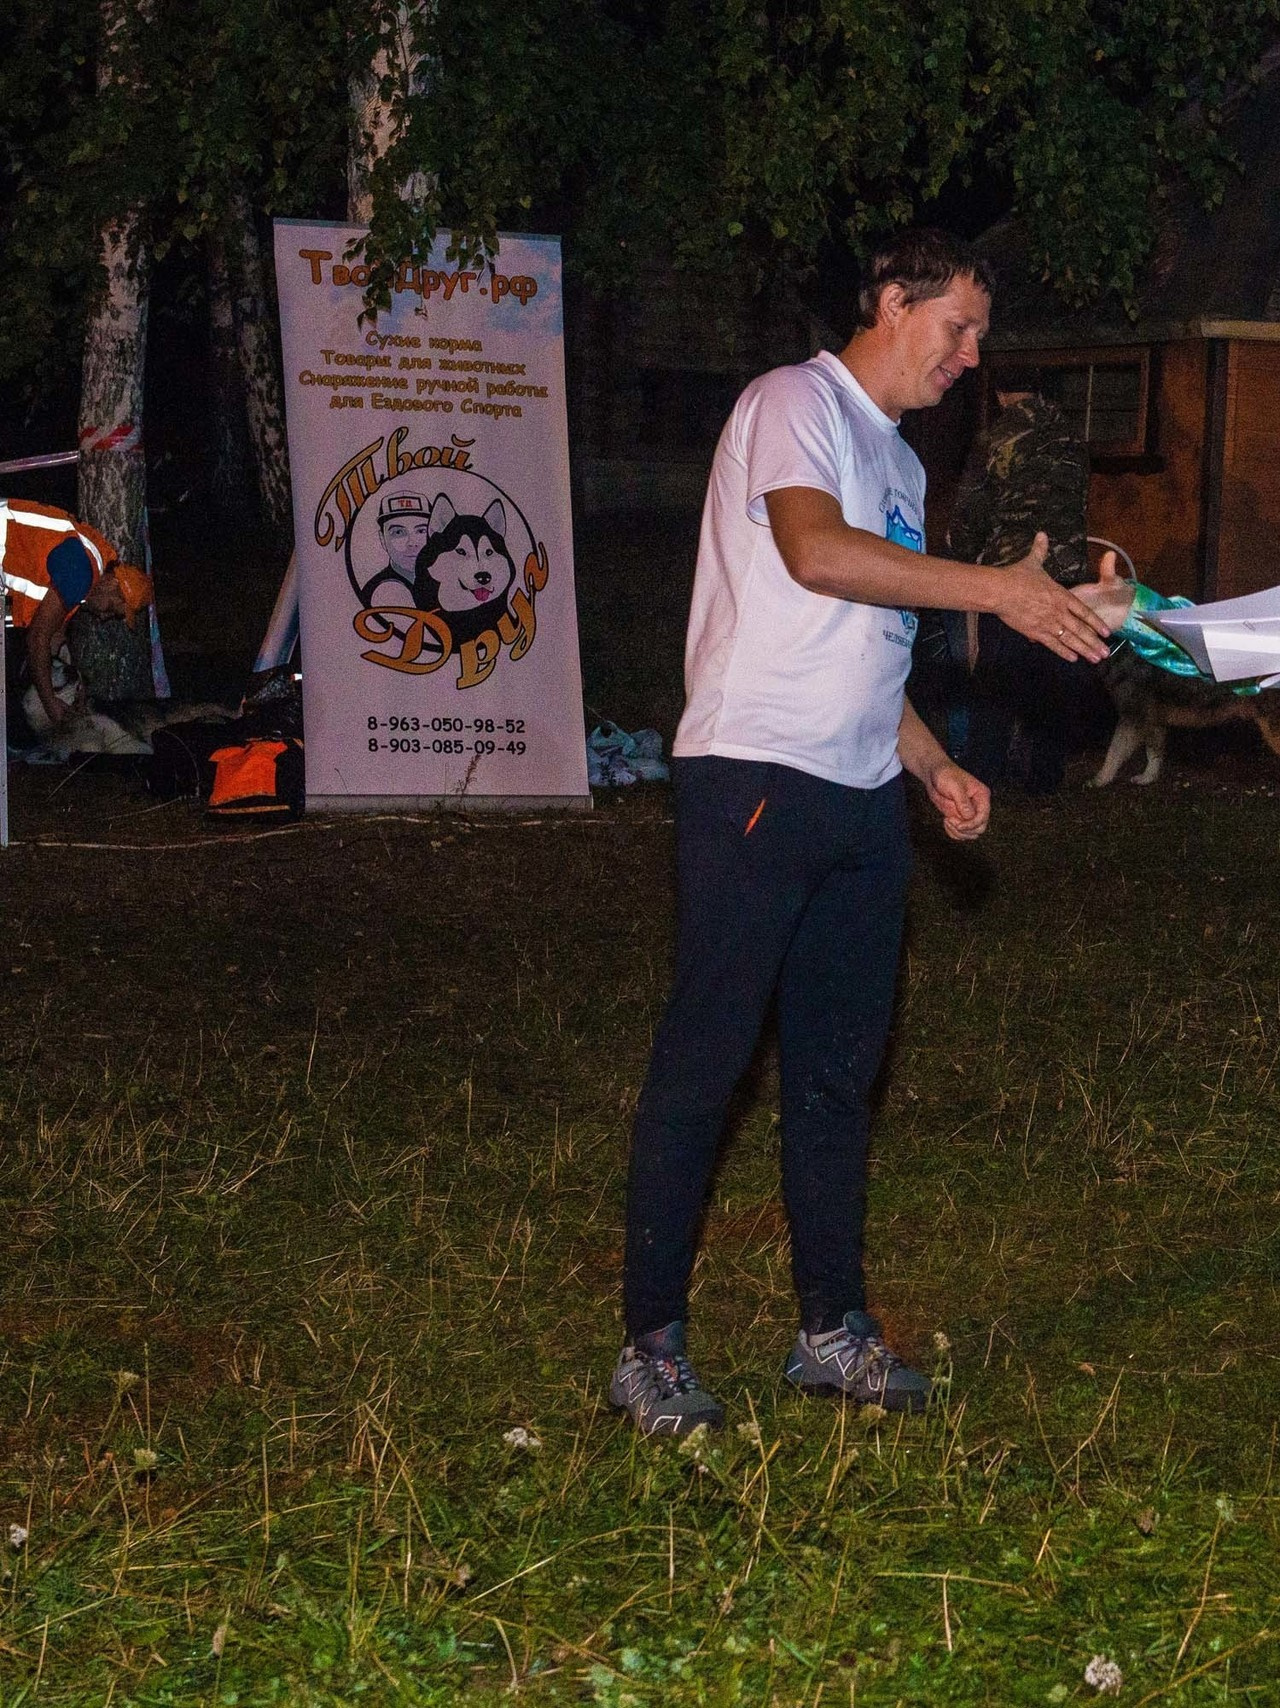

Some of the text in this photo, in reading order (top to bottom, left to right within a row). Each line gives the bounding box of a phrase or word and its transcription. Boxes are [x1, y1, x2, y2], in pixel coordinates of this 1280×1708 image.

[299, 249, 538, 304] ТвоДруг.рф
[365, 331, 482, 355] Сухие корма
[320, 350, 526, 375] Товары для животных
[299, 370, 548, 398] Снаряжение ручной работы
[329, 393, 522, 418] для Ездового Спорта
[314, 426, 476, 552] Твой
[352, 542, 549, 690] Друг
[367, 716, 526, 734] 8-963-050-98-52
[367, 739, 527, 756] 8-903-085-09-49
